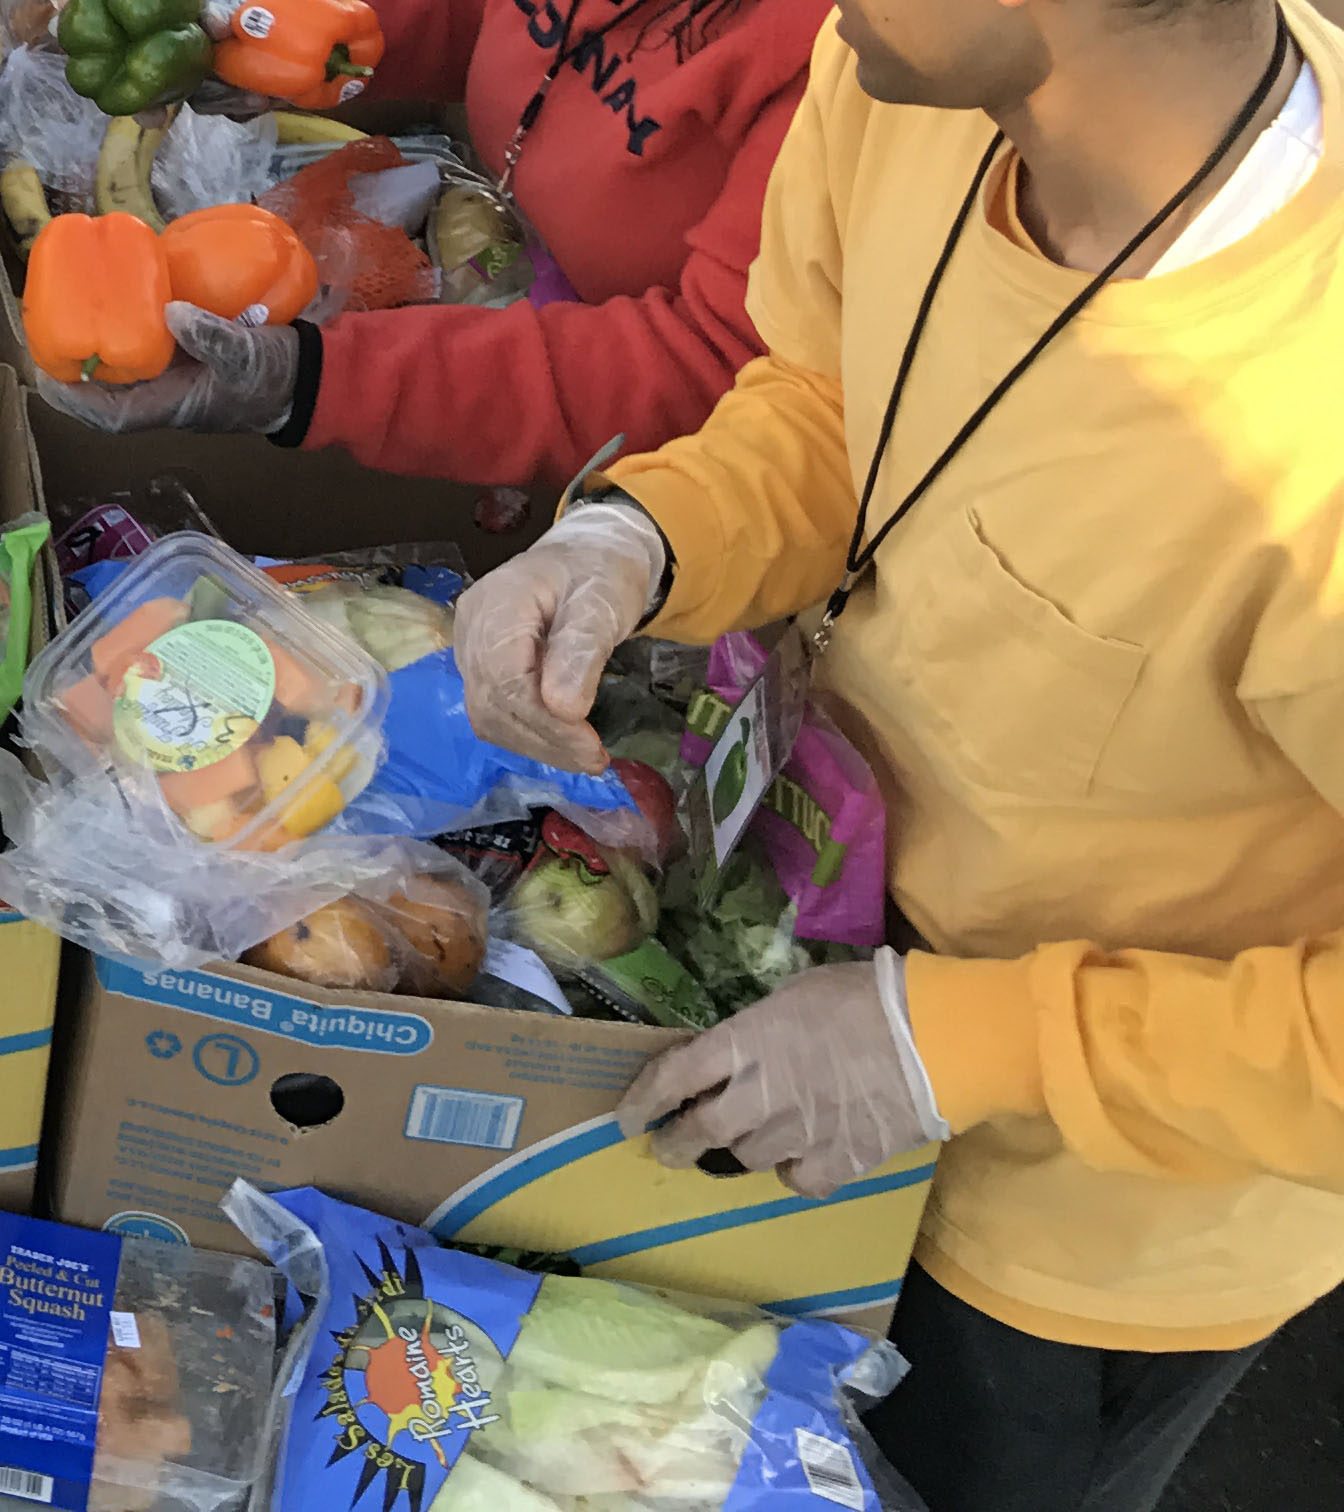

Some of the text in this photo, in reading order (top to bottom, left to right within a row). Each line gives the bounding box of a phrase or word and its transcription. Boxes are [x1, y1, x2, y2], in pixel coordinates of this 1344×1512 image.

[142, 971, 418, 1045] Chiquita Bananas
[7, 1287, 87, 1322] Squash
[399, 1325, 454, 1443] Romaine
[438, 1323, 502, 1432] Hearts
[364, 1441, 416, 1491] Les
